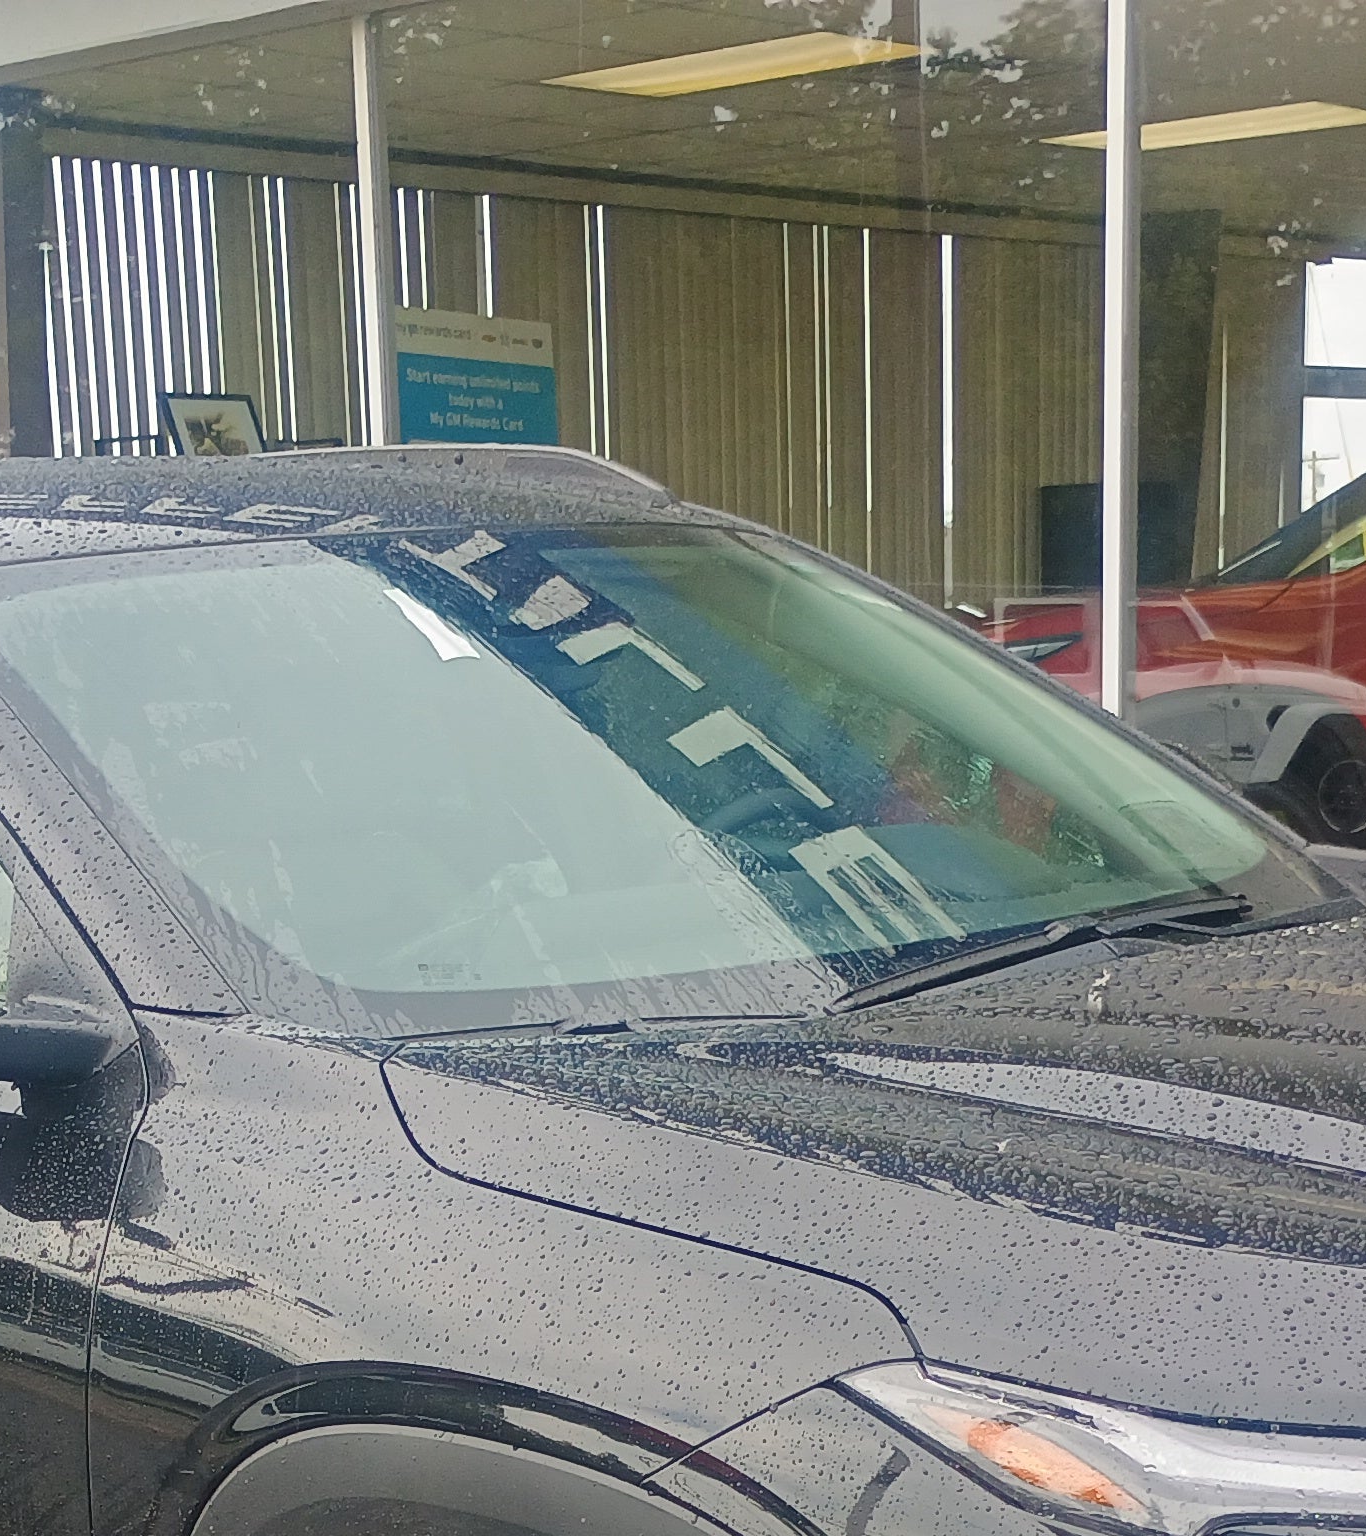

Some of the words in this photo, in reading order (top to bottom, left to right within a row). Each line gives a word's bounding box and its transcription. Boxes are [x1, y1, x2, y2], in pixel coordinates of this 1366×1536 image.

[406, 367, 431, 385] Start
[432, 373, 468, 390] earning
[469, 375, 511, 391] unlimited
[512, 380, 541, 394] points
[448, 392, 476, 411] today
[476, 395, 496, 410] with
[497, 398, 504, 411] a
[429, 410, 444, 429] My
[445, 411, 462, 428] GM
[462, 413, 502, 431] Rewards
[502, 416, 525, 433] Card
